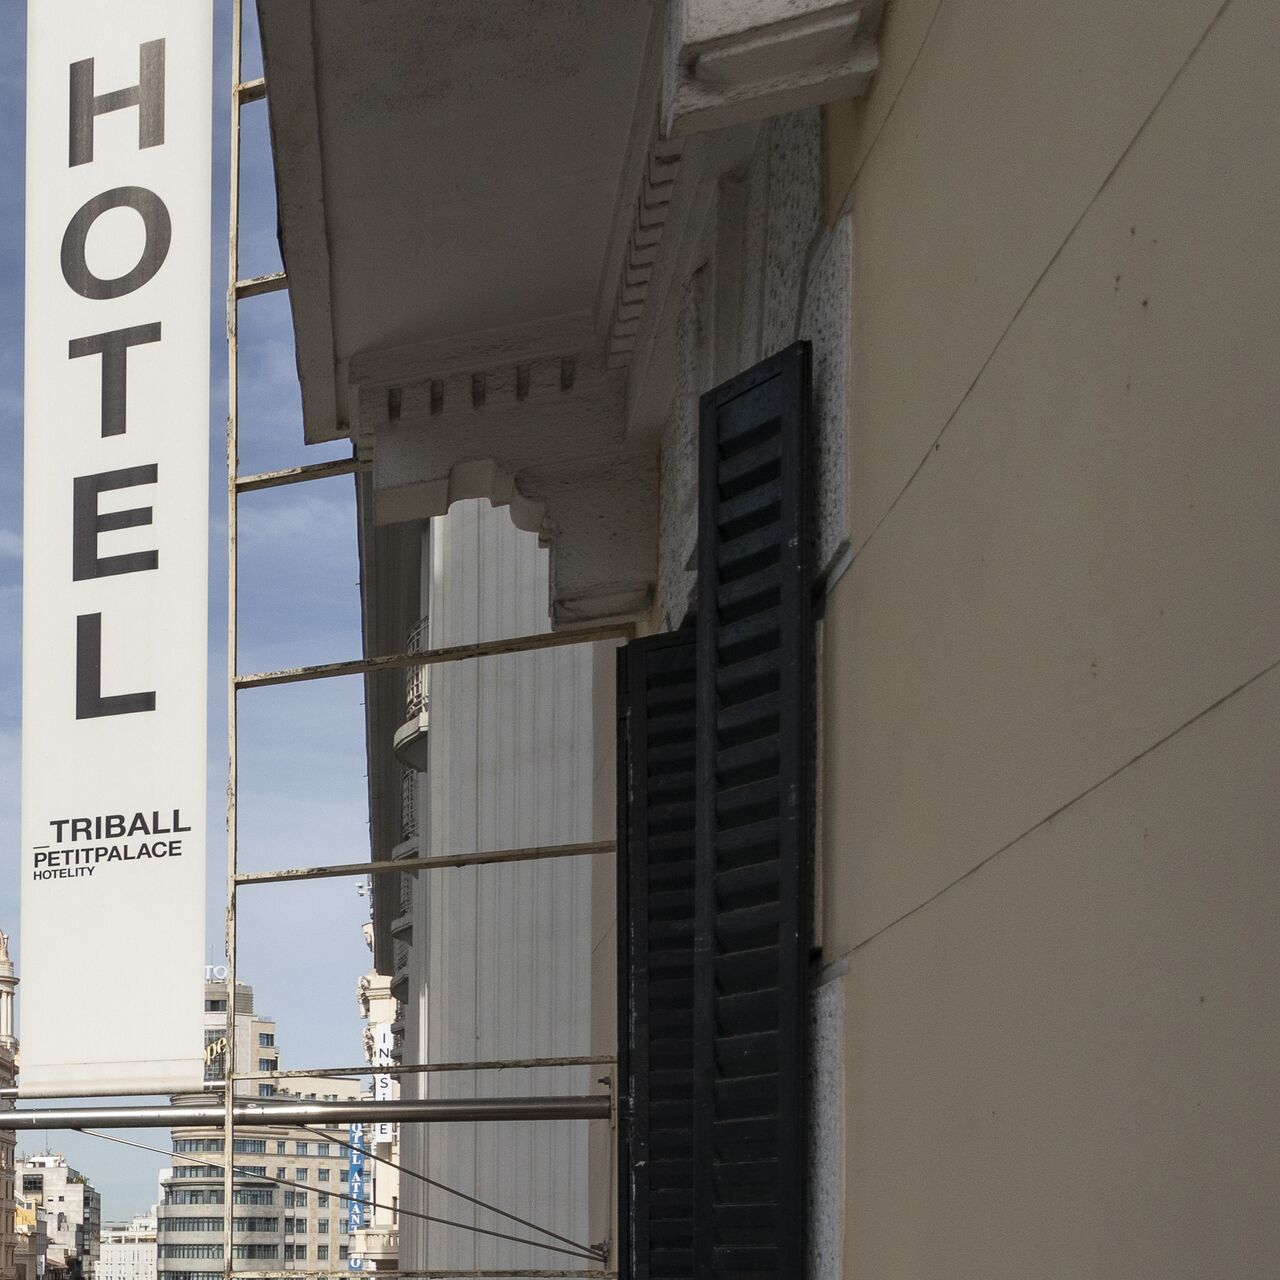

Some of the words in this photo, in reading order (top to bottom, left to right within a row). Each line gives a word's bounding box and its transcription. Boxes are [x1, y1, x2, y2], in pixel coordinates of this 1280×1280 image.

[60, 37, 172, 720] HOTEL
[50, 809, 191, 843] TRIBALL
[34, 840, 182, 868] PETITPALACE
[33, 866, 95, 880] HOTELITY
